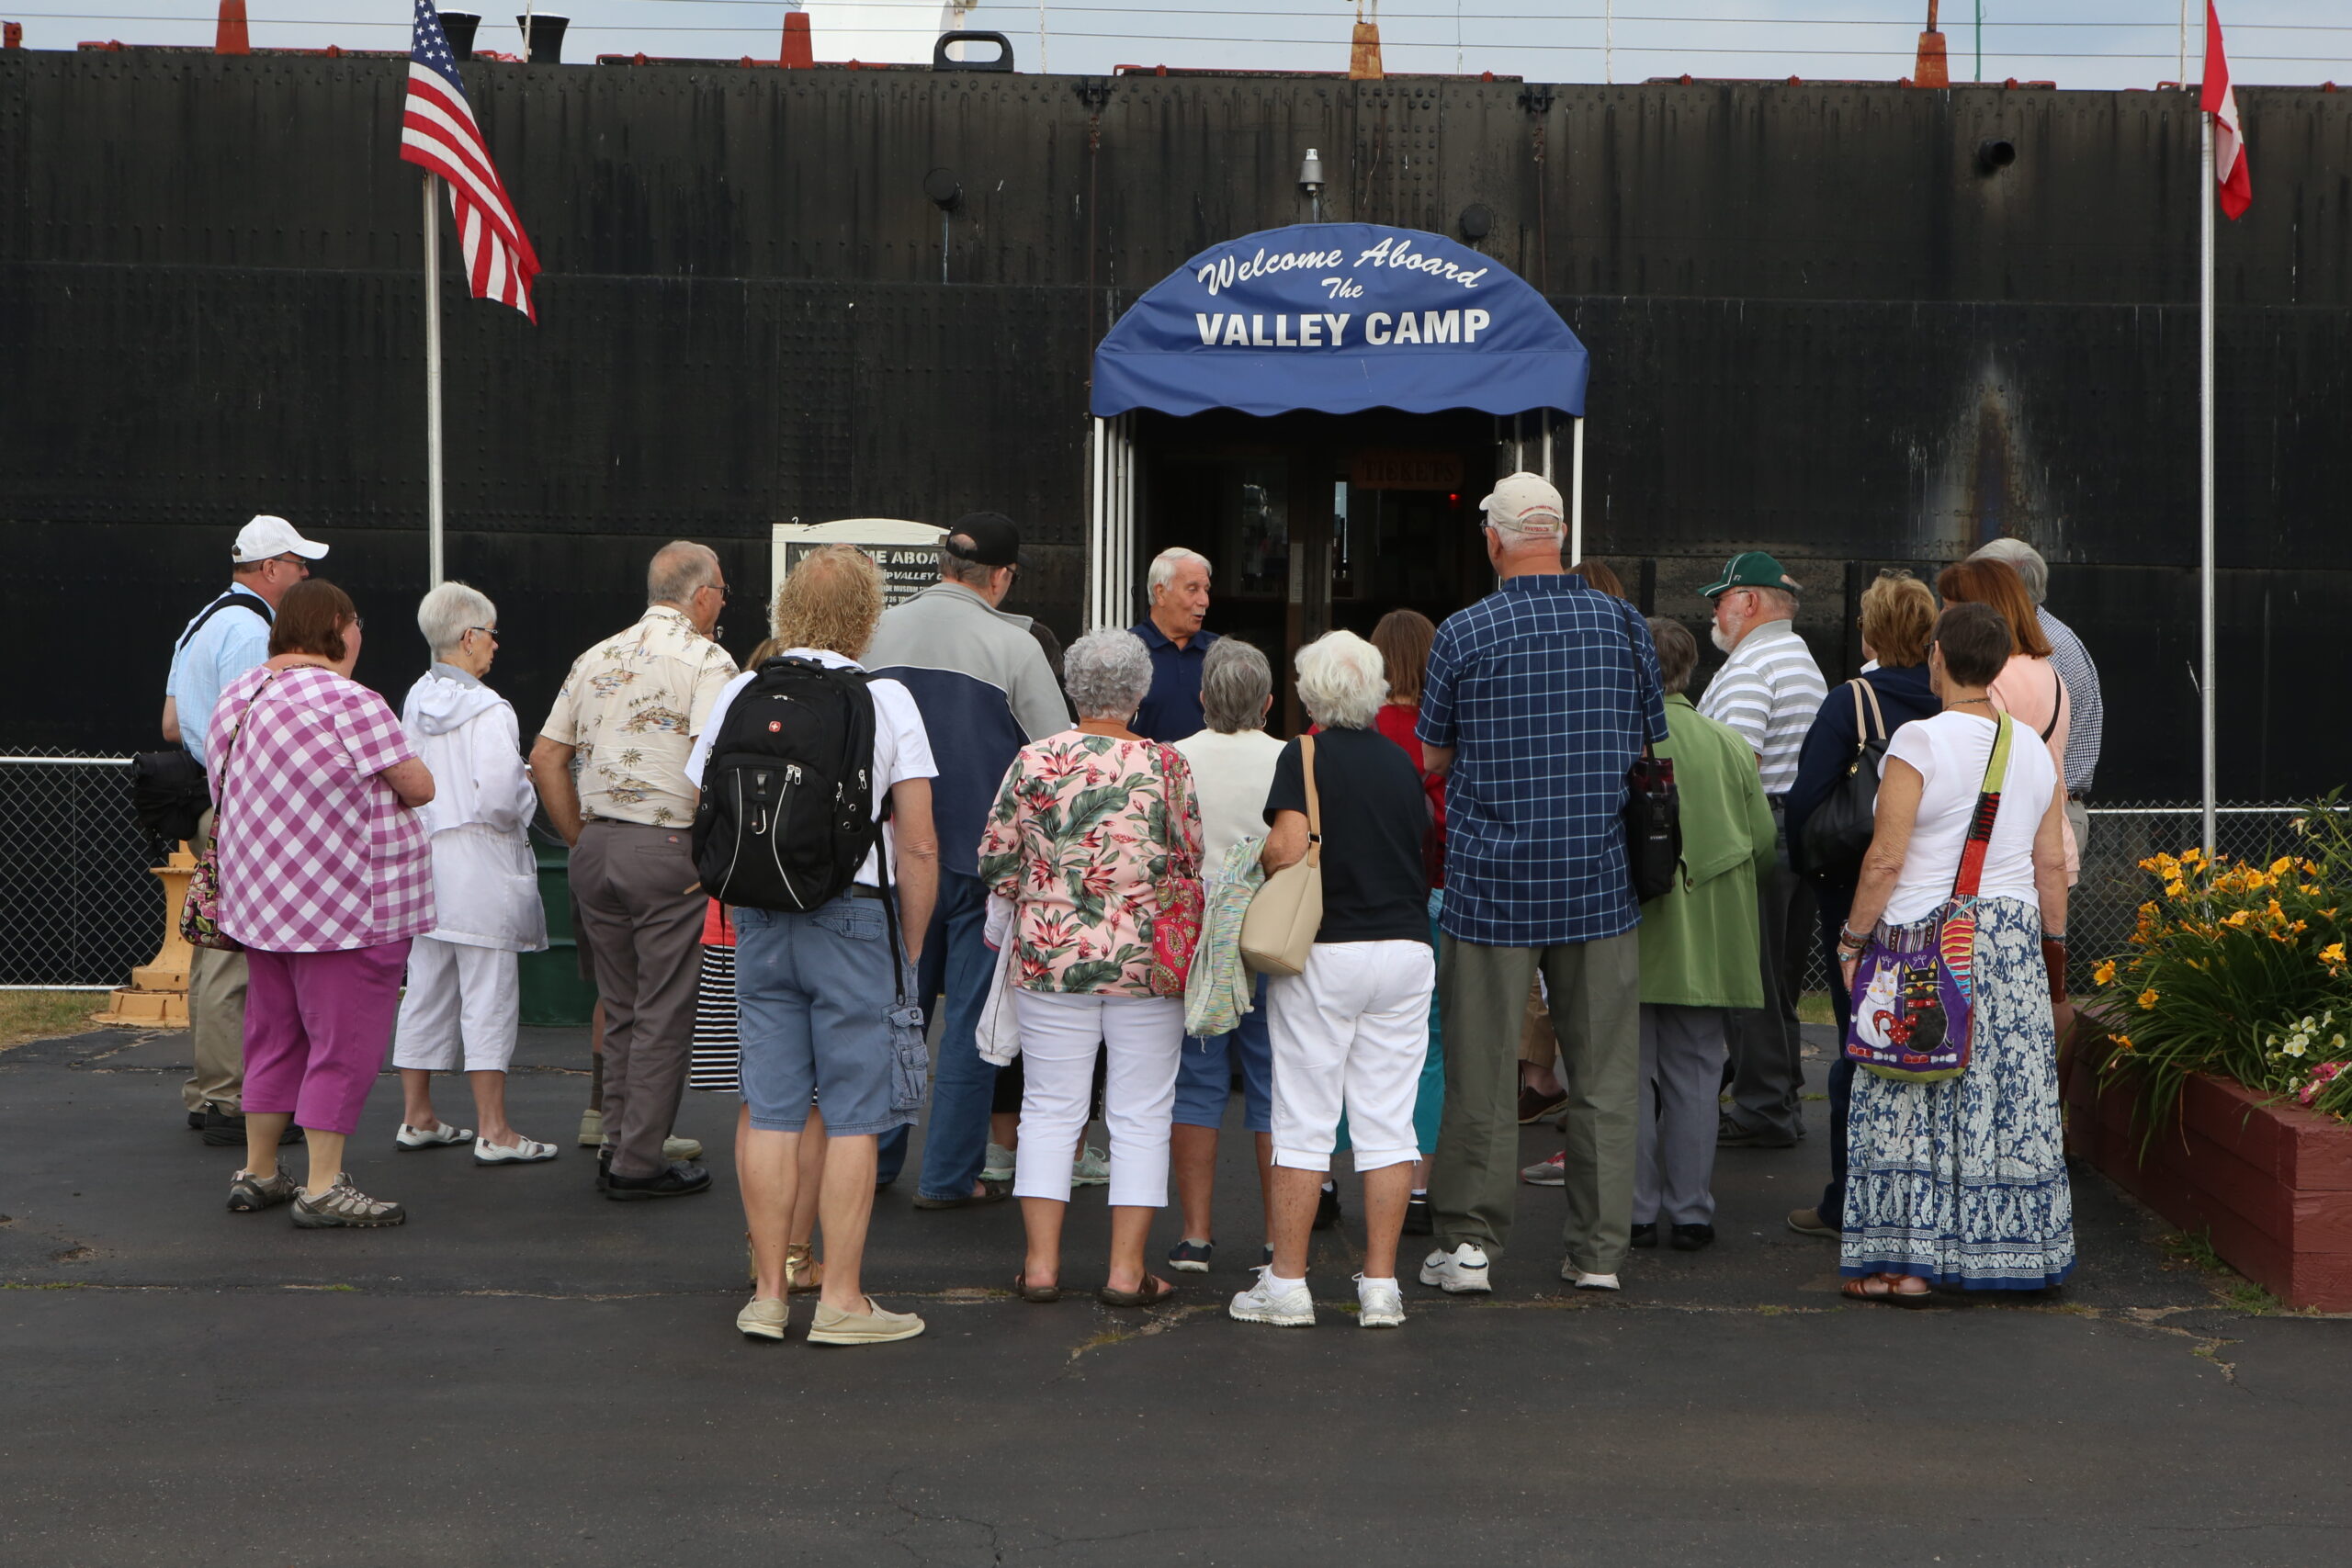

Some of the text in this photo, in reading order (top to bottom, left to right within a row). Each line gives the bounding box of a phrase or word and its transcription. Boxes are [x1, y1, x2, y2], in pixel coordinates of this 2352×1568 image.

[1197, 237, 1488, 296] Welcome Aboard
[1321, 277, 1363, 299] The
[1195, 309, 1490, 347] VALLEY CAMP
[1361, 461, 1456, 482] TICKETS
[891, 551, 940, 565] ABOA
[893, 571, 935, 581] VALLEY
